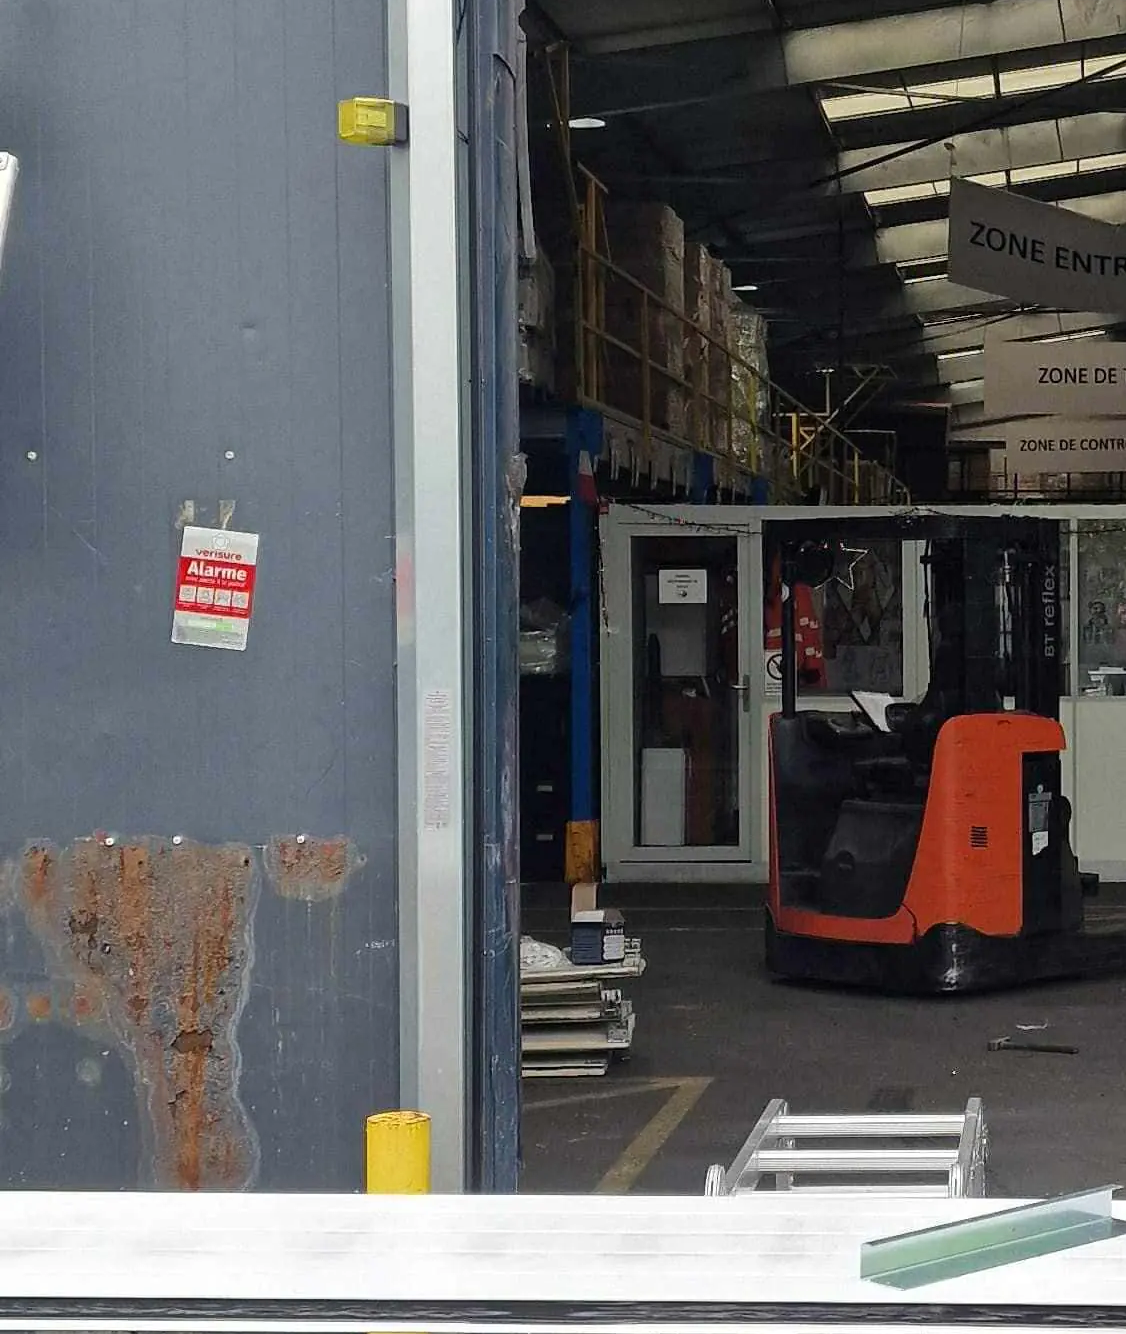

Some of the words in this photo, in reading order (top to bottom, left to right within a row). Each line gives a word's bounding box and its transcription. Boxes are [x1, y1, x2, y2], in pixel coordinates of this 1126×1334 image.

[969, 220, 1045, 264] ZONE
[1038, 367, 1088, 384] ZONE
[1094, 367, 1118, 384] DE
[1019, 438, 1056, 452] ZONE
[1059, 438, 1077, 452] DE
[195, 548, 242, 561] verisure
[187, 560, 248, 581] Alarme
[1042, 565, 1056, 627] reflex
[1044, 633, 1055, 657] BT
